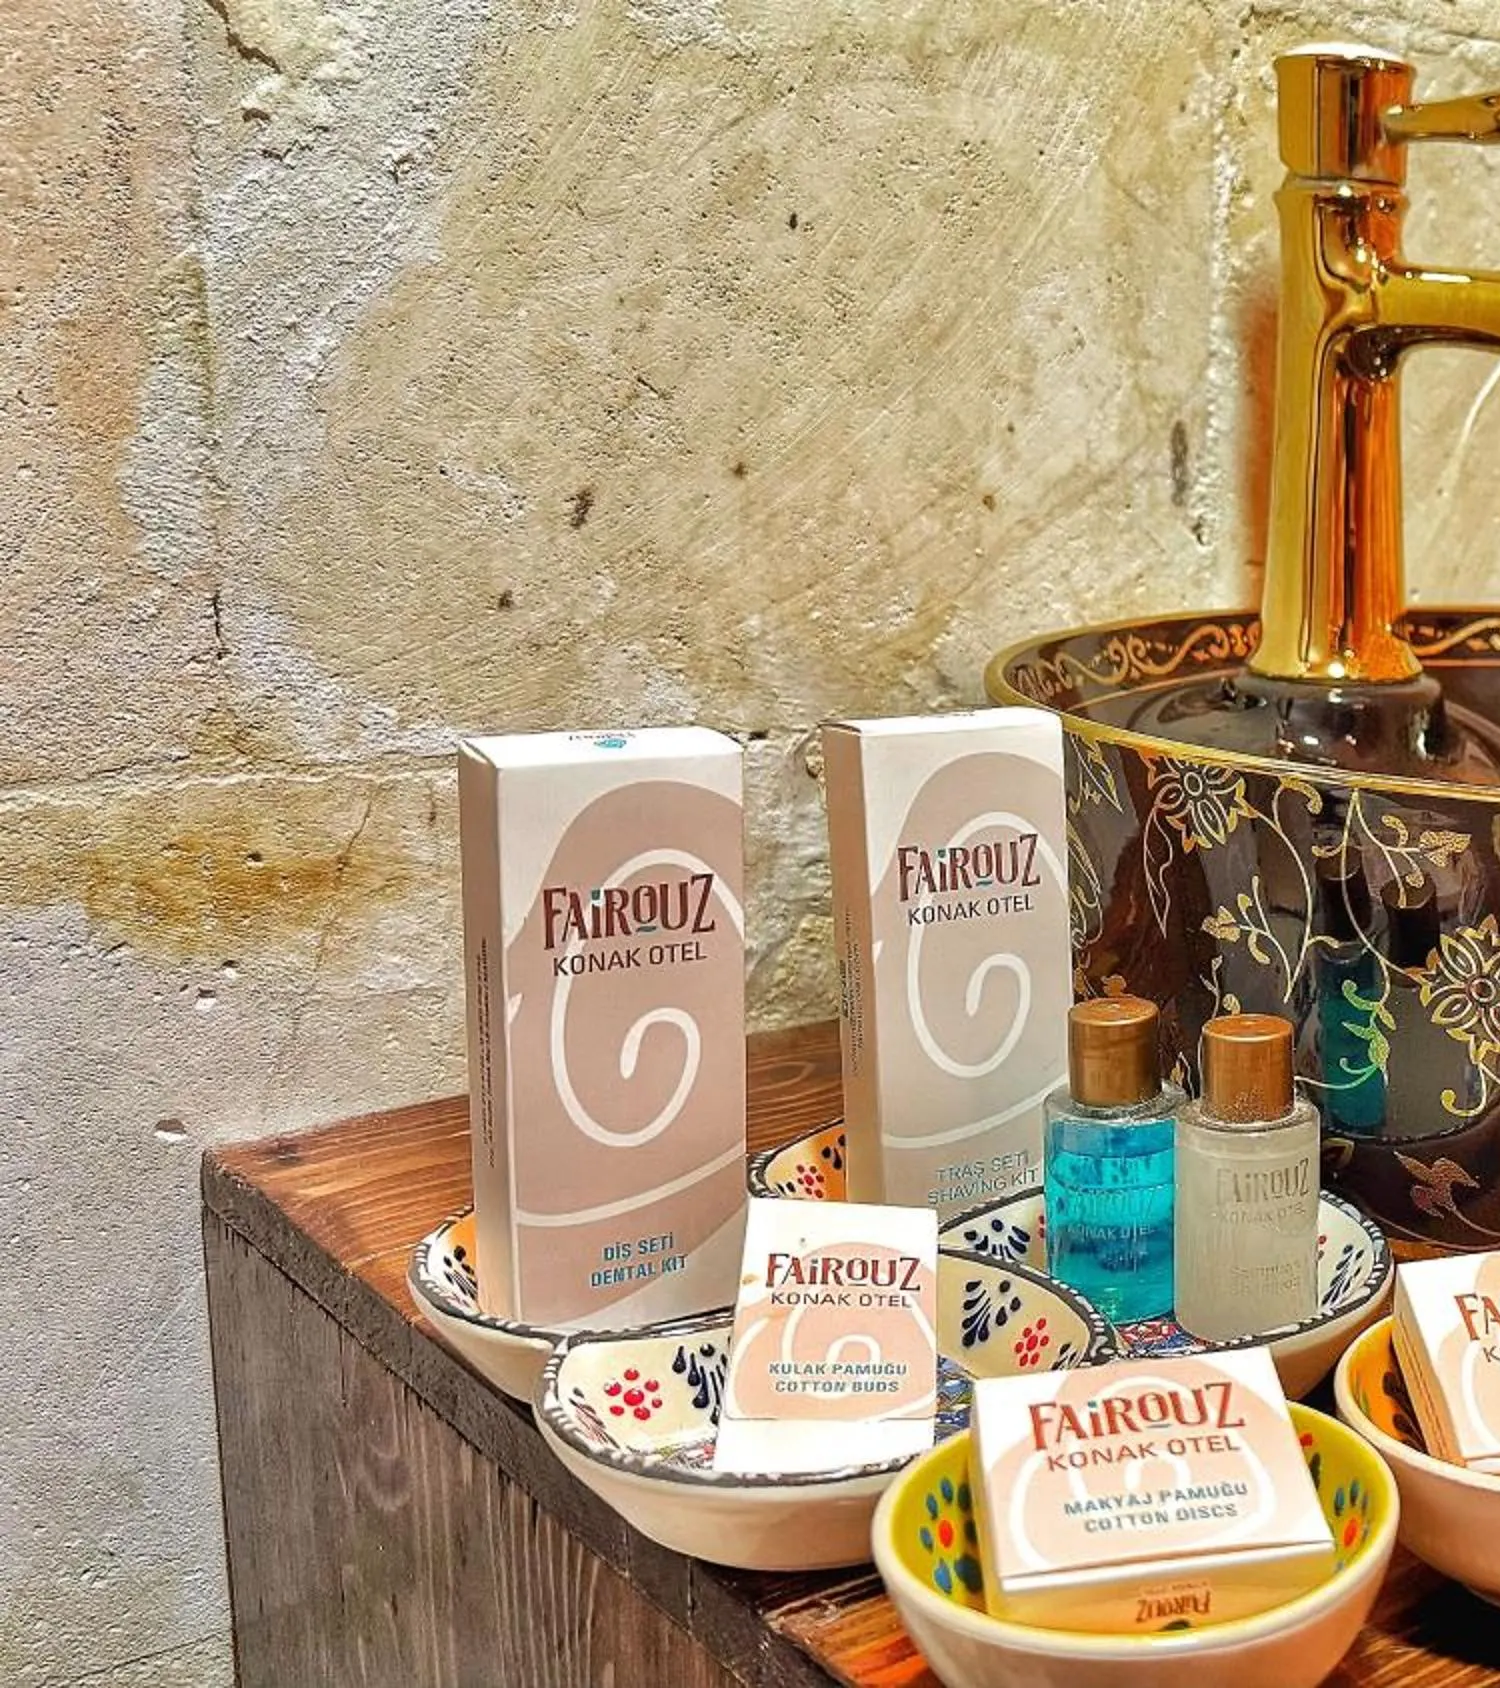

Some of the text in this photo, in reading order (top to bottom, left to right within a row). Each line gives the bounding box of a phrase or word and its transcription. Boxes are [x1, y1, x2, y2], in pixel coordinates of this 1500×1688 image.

[908, 893, 1035, 926] KONAK OTEL
[553, 941, 707, 977] KONAK OTEL
[591, 1261, 657, 1287] DENTAL
[771, 1292, 913, 1308] KONAK OTEL
[769, 1363, 827, 1375] KULAK
[775, 1381, 900, 1393] COTTON BUDS
[1048, 1434, 1241, 1472] KONAK OTEL
[1063, 1493, 1153, 1517] MAKYAJ
[1084, 1503, 1238, 1534] COTTON DISCS
